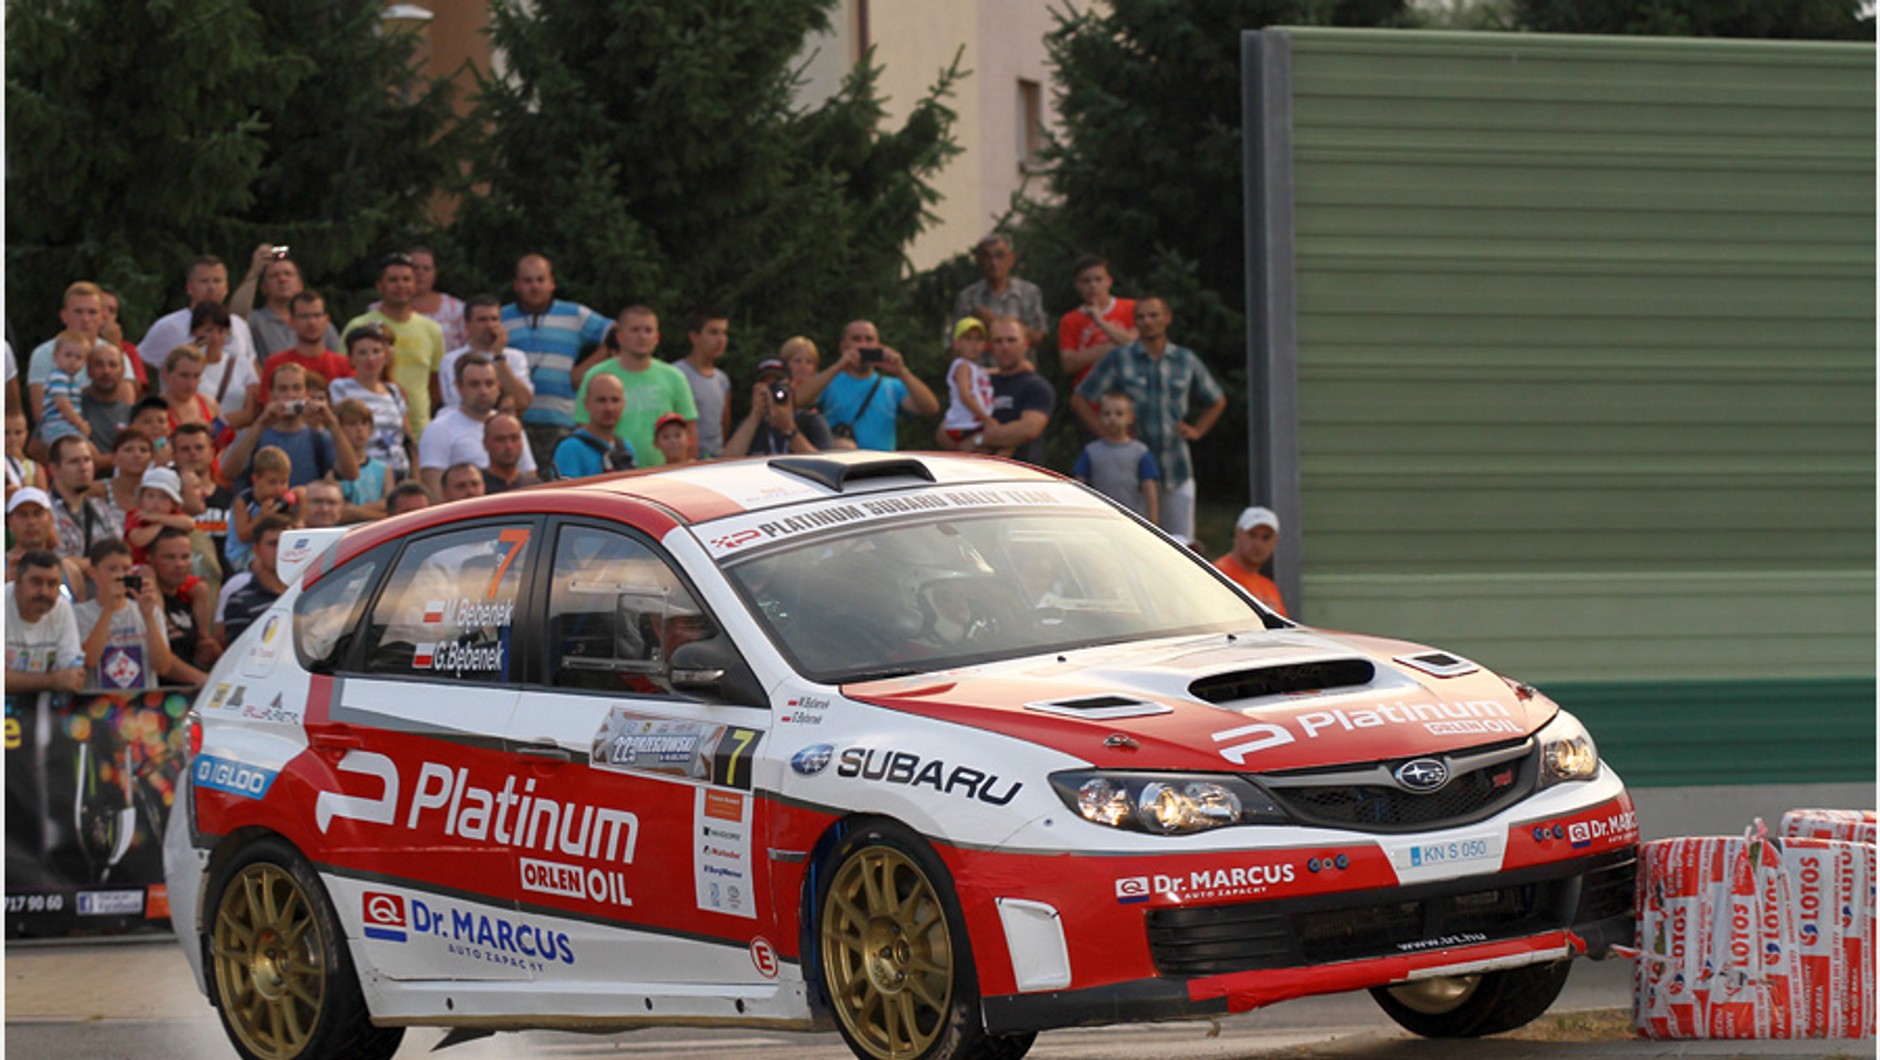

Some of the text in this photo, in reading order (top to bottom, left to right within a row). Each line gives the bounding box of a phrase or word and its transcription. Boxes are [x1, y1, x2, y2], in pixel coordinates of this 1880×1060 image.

[758, 505, 866, 537] PLATINUM
[861, 493, 949, 516] SUBARU
[943, 490, 1006, 506] RALLY
[487, 528, 531, 599] 7
[434, 640, 505, 678] G.Bębenek
[1296, 699, 1510, 738] Platinum
[1483, 720, 1524, 732] OIL
[726, 729, 755, 786] 7
[837, 748, 1023, 806] SUBARU
[211, 763, 265, 794] IGLOO
[407, 761, 639, 864] Platinum
[1424, 841, 1487, 862] KN S 050
[525, 863, 633, 906] ORLEN OIL
[1190, 864, 1296, 891] MARCUS
[1800, 856, 1820, 919] LOTOS
[28, 895, 44, 911] 90
[46, 894, 63, 910] 60
[448, 942, 482, 960] AUTO
[451, 908, 575, 966] MARCUS
[1731, 904, 1750, 967] LOTOS
[756, 945, 774, 971] E
